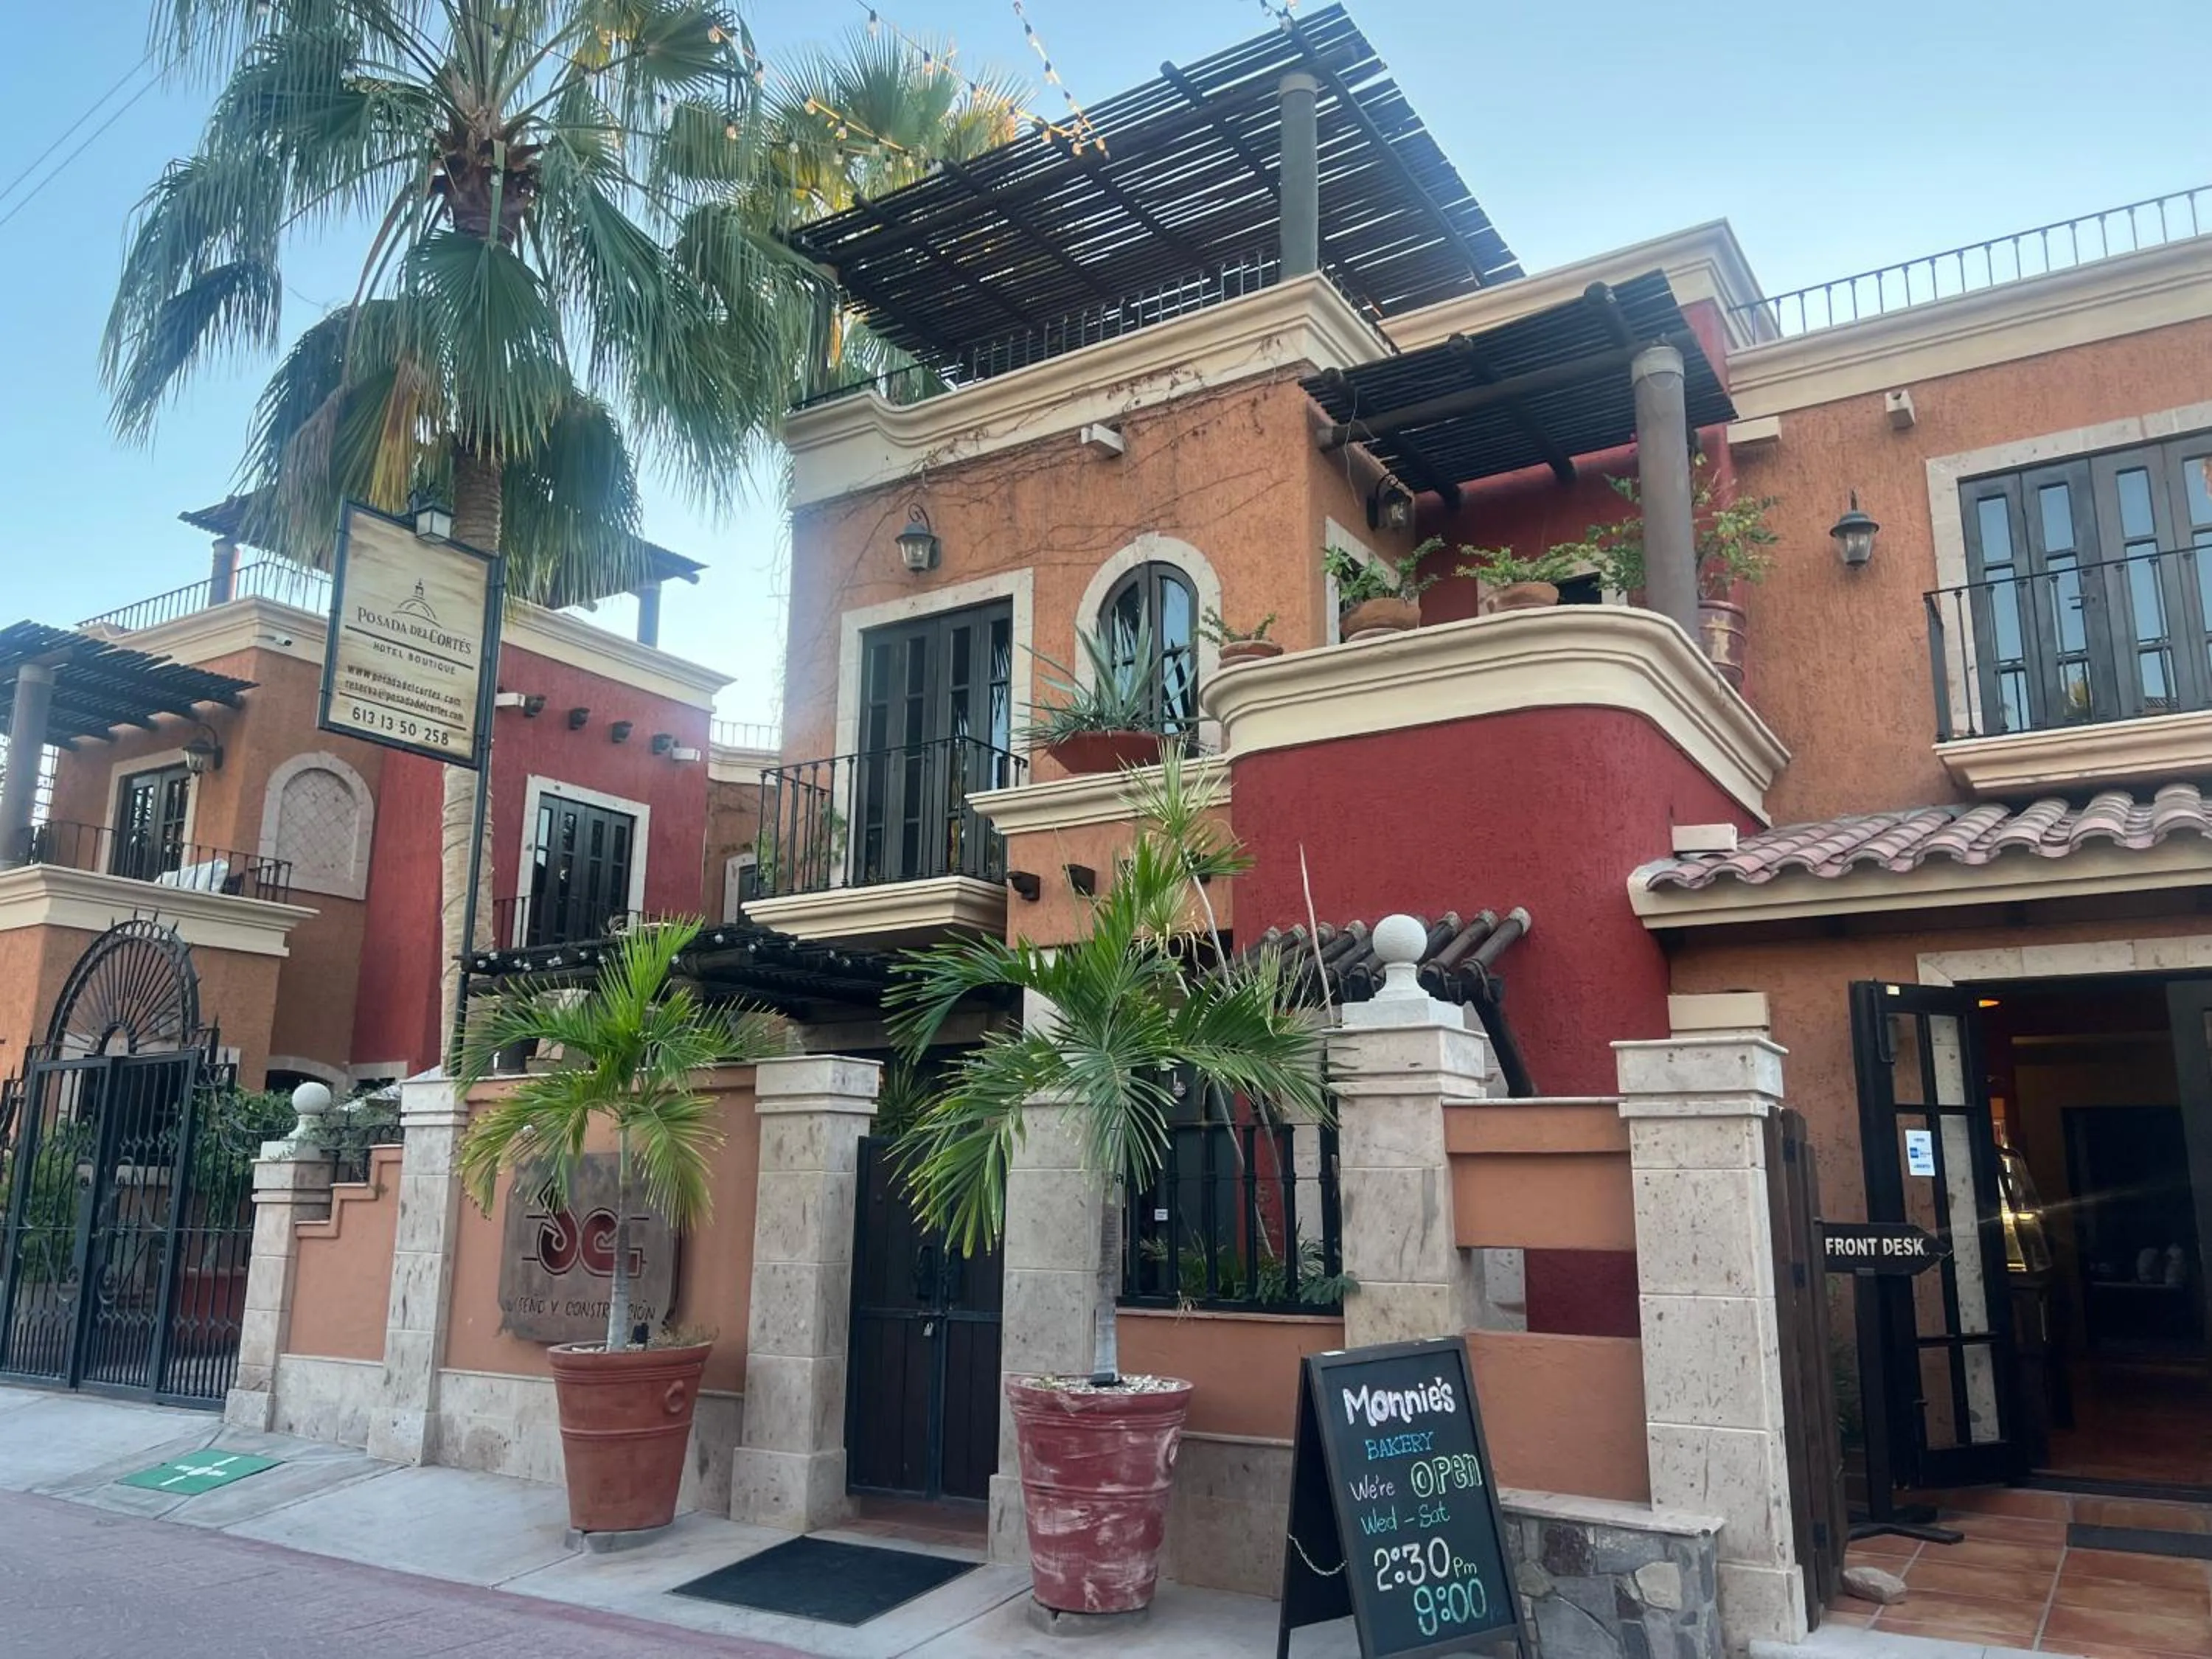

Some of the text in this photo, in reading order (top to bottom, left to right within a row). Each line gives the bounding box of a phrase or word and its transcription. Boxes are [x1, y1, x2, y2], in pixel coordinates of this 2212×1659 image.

[357, 605, 407, 634] POSADA
[429, 629, 471, 654] CORTÉS
[373, 641, 456, 675] HOTEL BOUTIQUE
[352, 706, 375, 724] 613
[424, 728, 449, 745] 258
[1825, 1237, 1924, 1256] FRONT DESK
[1343, 1377, 1456, 1427] Monnie's
[1364, 1431, 1434, 1461] BAKERY
[1349, 1474, 1396, 1501] We're
[1361, 1506, 1397, 1534] Wed
[1419, 1500, 1451, 1529] Sat
[1374, 1537, 1450, 1592] 2:30
[1413, 1577, 1486, 1637] 9:00
